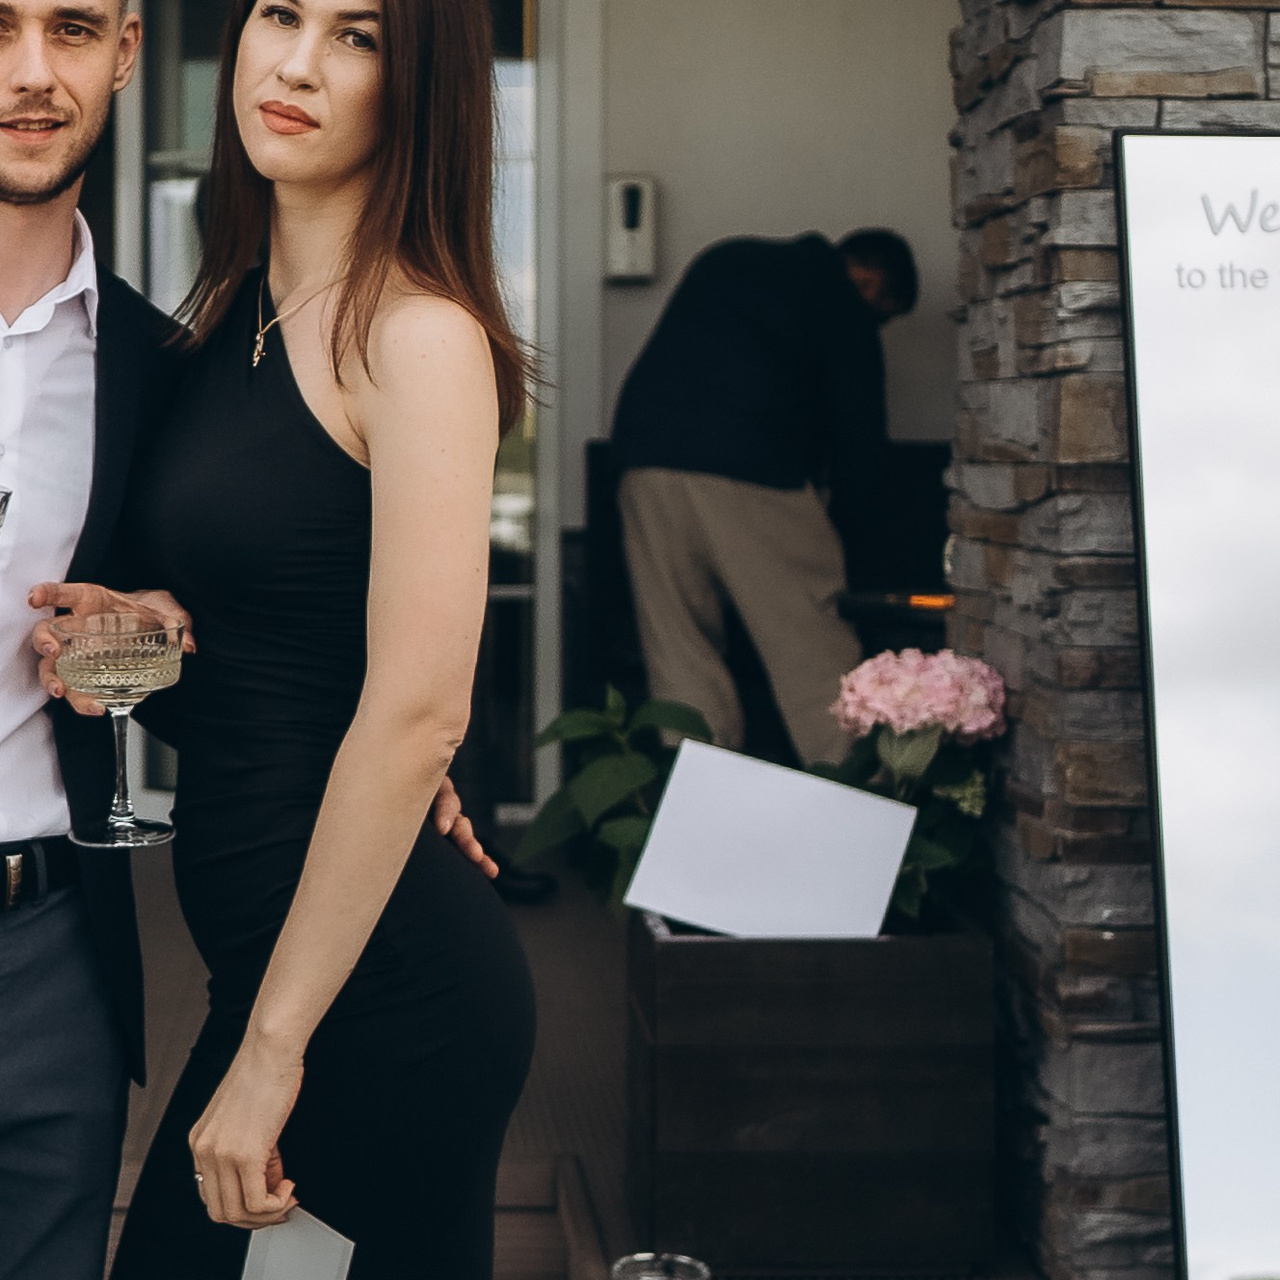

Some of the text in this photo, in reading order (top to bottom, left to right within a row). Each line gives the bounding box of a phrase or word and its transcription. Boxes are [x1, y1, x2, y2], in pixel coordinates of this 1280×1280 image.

[1200, 187, 1280, 236] We
[1174, 261, 1269, 289] to the
